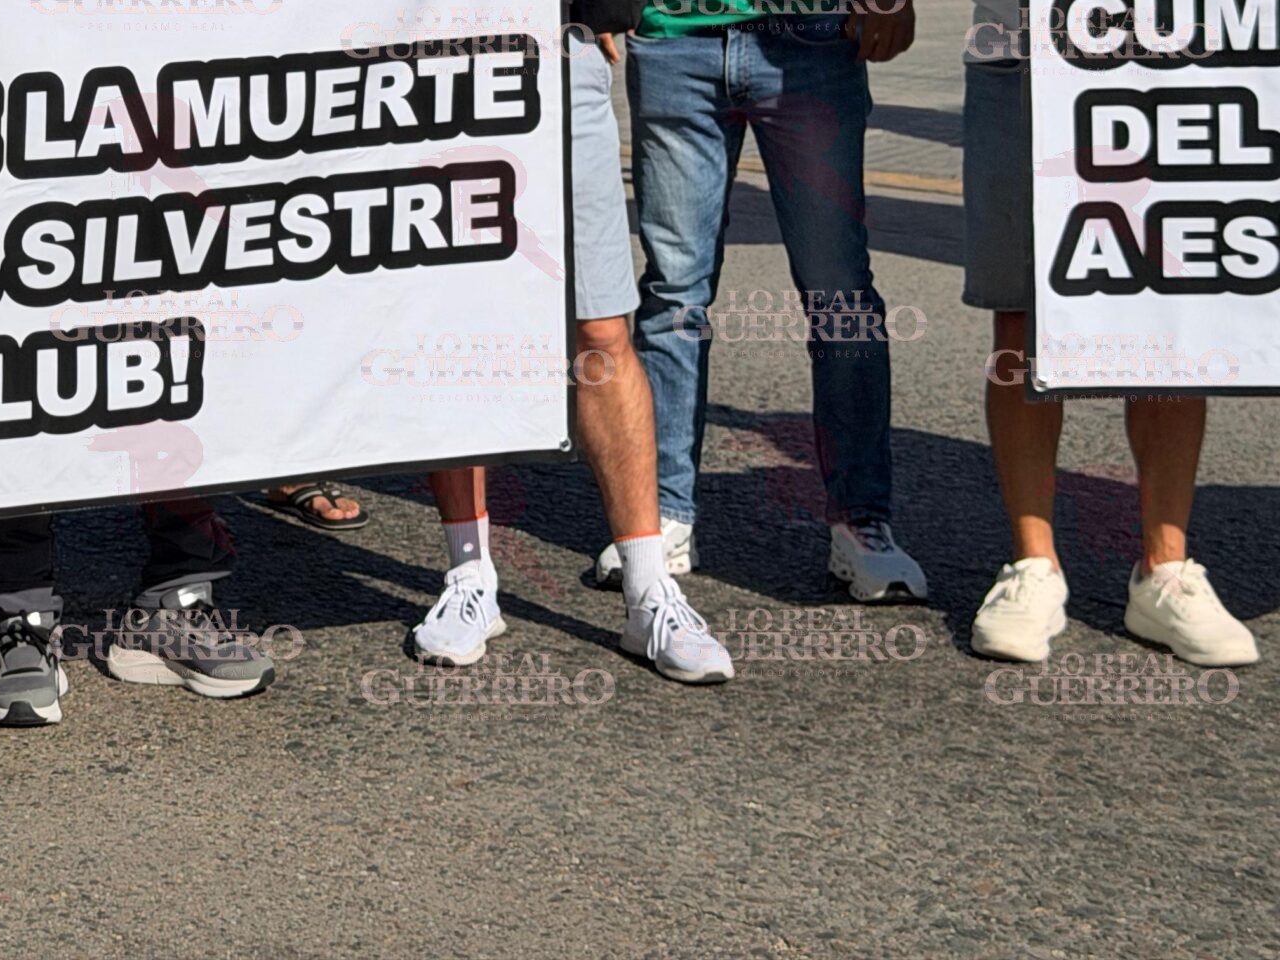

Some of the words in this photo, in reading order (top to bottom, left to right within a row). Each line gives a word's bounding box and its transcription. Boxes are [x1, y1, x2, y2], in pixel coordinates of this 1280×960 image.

[22, 83, 145, 164] LA
[169, 50, 527, 152] MUERTE
[1088, 101, 1274, 168] DEL
[15, 175, 504, 292] SILVESTRE
[1062, 216, 1136, 281] A
